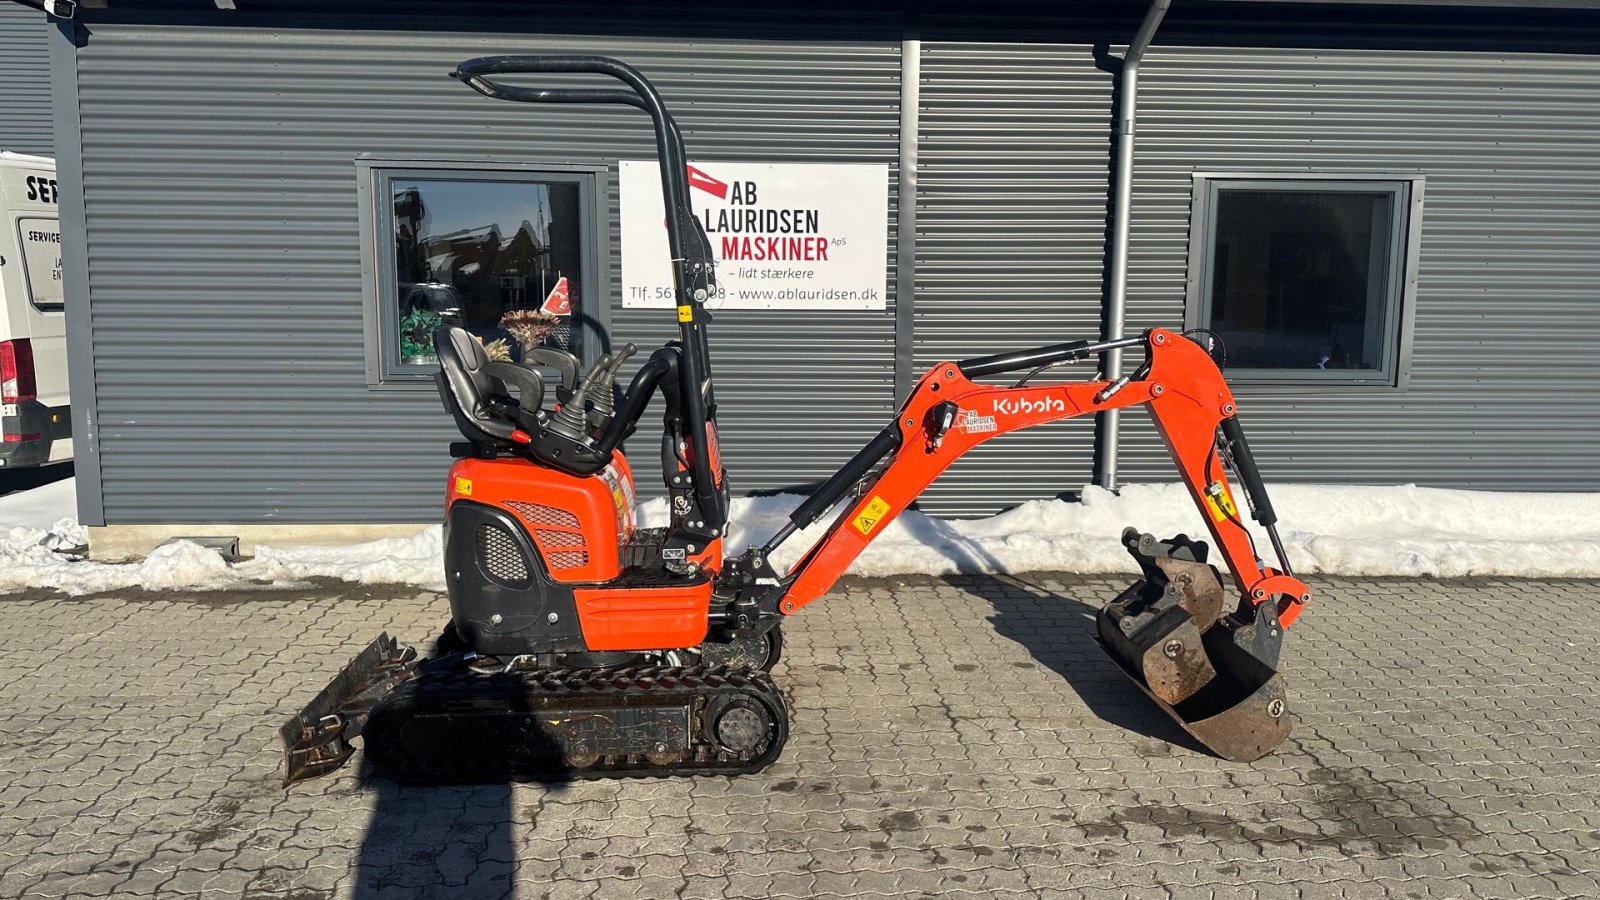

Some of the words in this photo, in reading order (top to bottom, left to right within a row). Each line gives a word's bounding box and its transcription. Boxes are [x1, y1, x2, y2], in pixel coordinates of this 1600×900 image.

[730, 181, 758, 206] AB
[705, 208, 819, 234] LAURIDSEN
[28, 230, 60, 243] SERVICE
[721, 236, 829, 261] MASKINER
[831, 237, 847, 246] ApS
[738, 267, 758, 279] lidt
[760, 267, 815, 279] stærkere
[630, 286, 652, 302] Tlf.
[738, 287, 879, 301] www.ablauridsen.dk
[993, 396, 1065, 415] Kubota
[962, 417, 994, 426] LAURIDSEN
[967, 423, 998, 432] MASKINER
